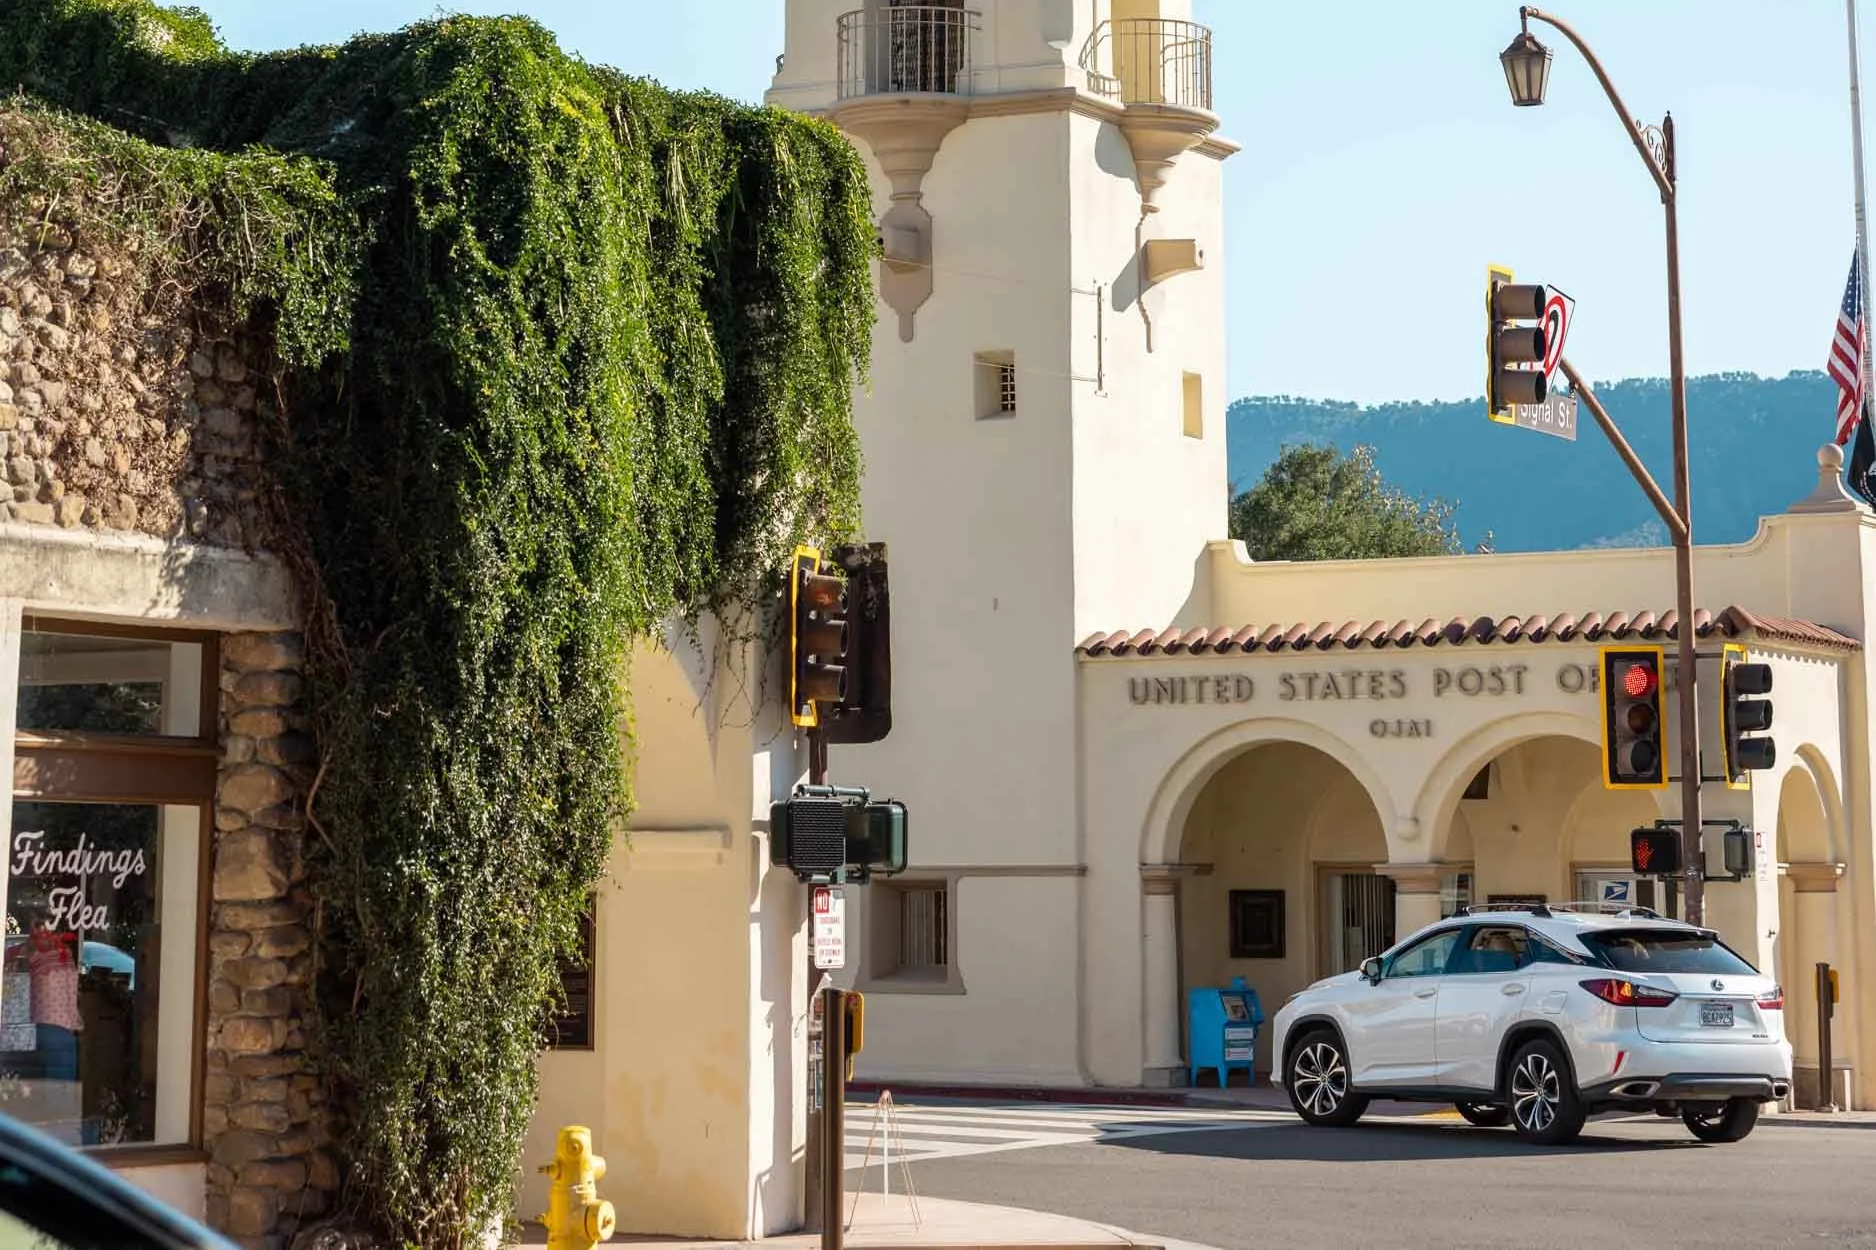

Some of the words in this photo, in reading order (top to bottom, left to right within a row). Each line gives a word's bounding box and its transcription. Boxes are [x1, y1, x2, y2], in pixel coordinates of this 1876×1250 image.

[1558, 401, 1573, 429] St.
[1128, 674, 1254, 705] UNITED
[1279, 669, 1406, 700] STATES
[1433, 664, 1528, 697] POST
[1369, 719, 1432, 738] OJAI
[11, 830, 146, 889] Findings
[45, 886, 110, 930] Flea
[817, 892, 829, 911] NO
